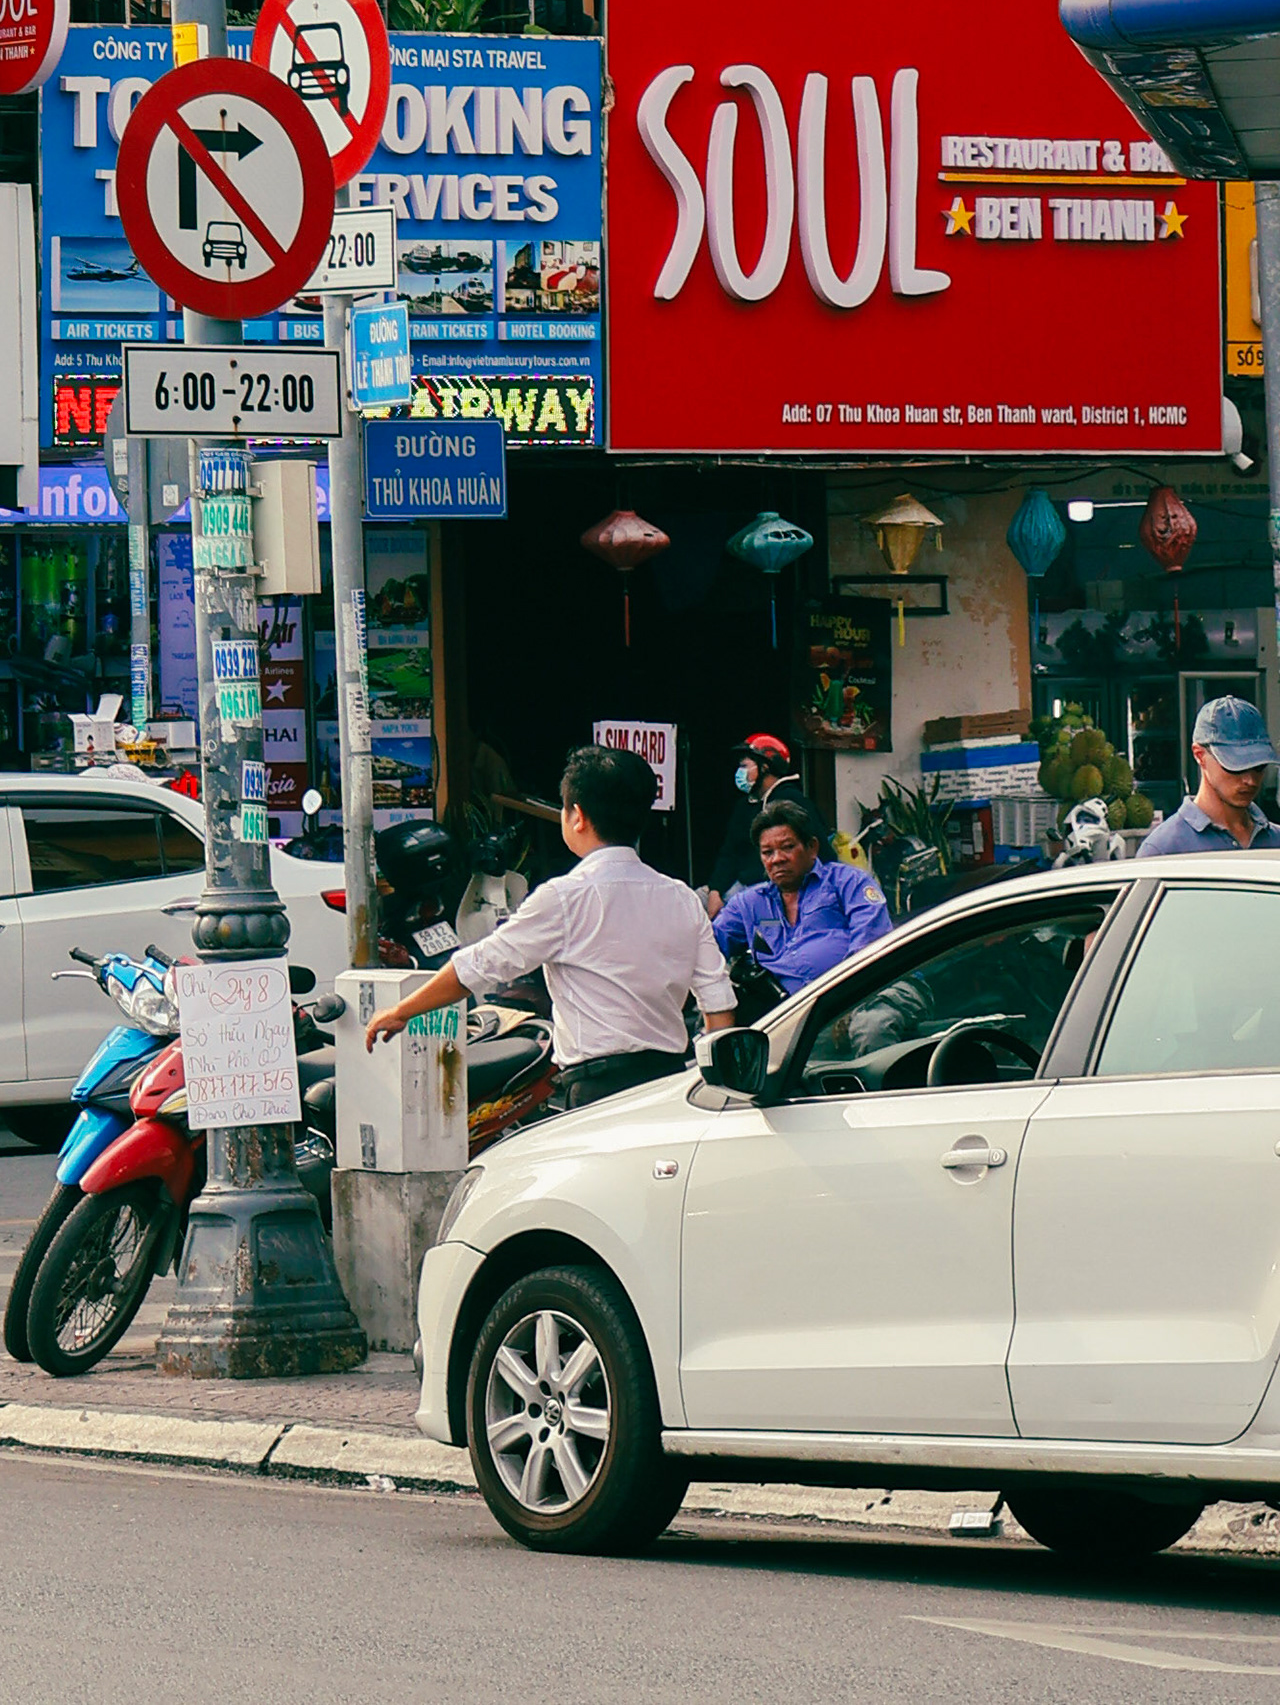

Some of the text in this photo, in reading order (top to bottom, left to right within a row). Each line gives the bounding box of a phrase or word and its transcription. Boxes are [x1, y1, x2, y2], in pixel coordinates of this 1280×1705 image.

[5, 46, 28, 60] THANH
[93, 39, 547, 72] CÔNG TY MẠI STA TRAVEL
[941, 135, 1176, 173] RESTAURANT & BA
[349, 173, 559, 221] ERVICES
[637, 64, 951, 309] SOUL
[975, 197, 1155, 241] BEN THANH
[67, 323, 153, 338] AIR TICKETS
[293, 324, 320, 338] BUS
[409, 324, 487, 337] TRAIN TICKETS
[511, 324, 595, 338] HOTEL BOOKING
[54, 354, 75, 367] Add:
[76, 354, 83, 367] 5
[86, 353, 102, 366] Thu
[782, 404, 1187, 427] Add: 07 Thu Khoa Huan str, Ben Thanh ward, District 1, HCMC
[395, 431, 476, 457] ĐƯỜNG
[373, 469, 501, 506] THỦ KHOA HUÂN
[264, 728, 297, 742] HAI
